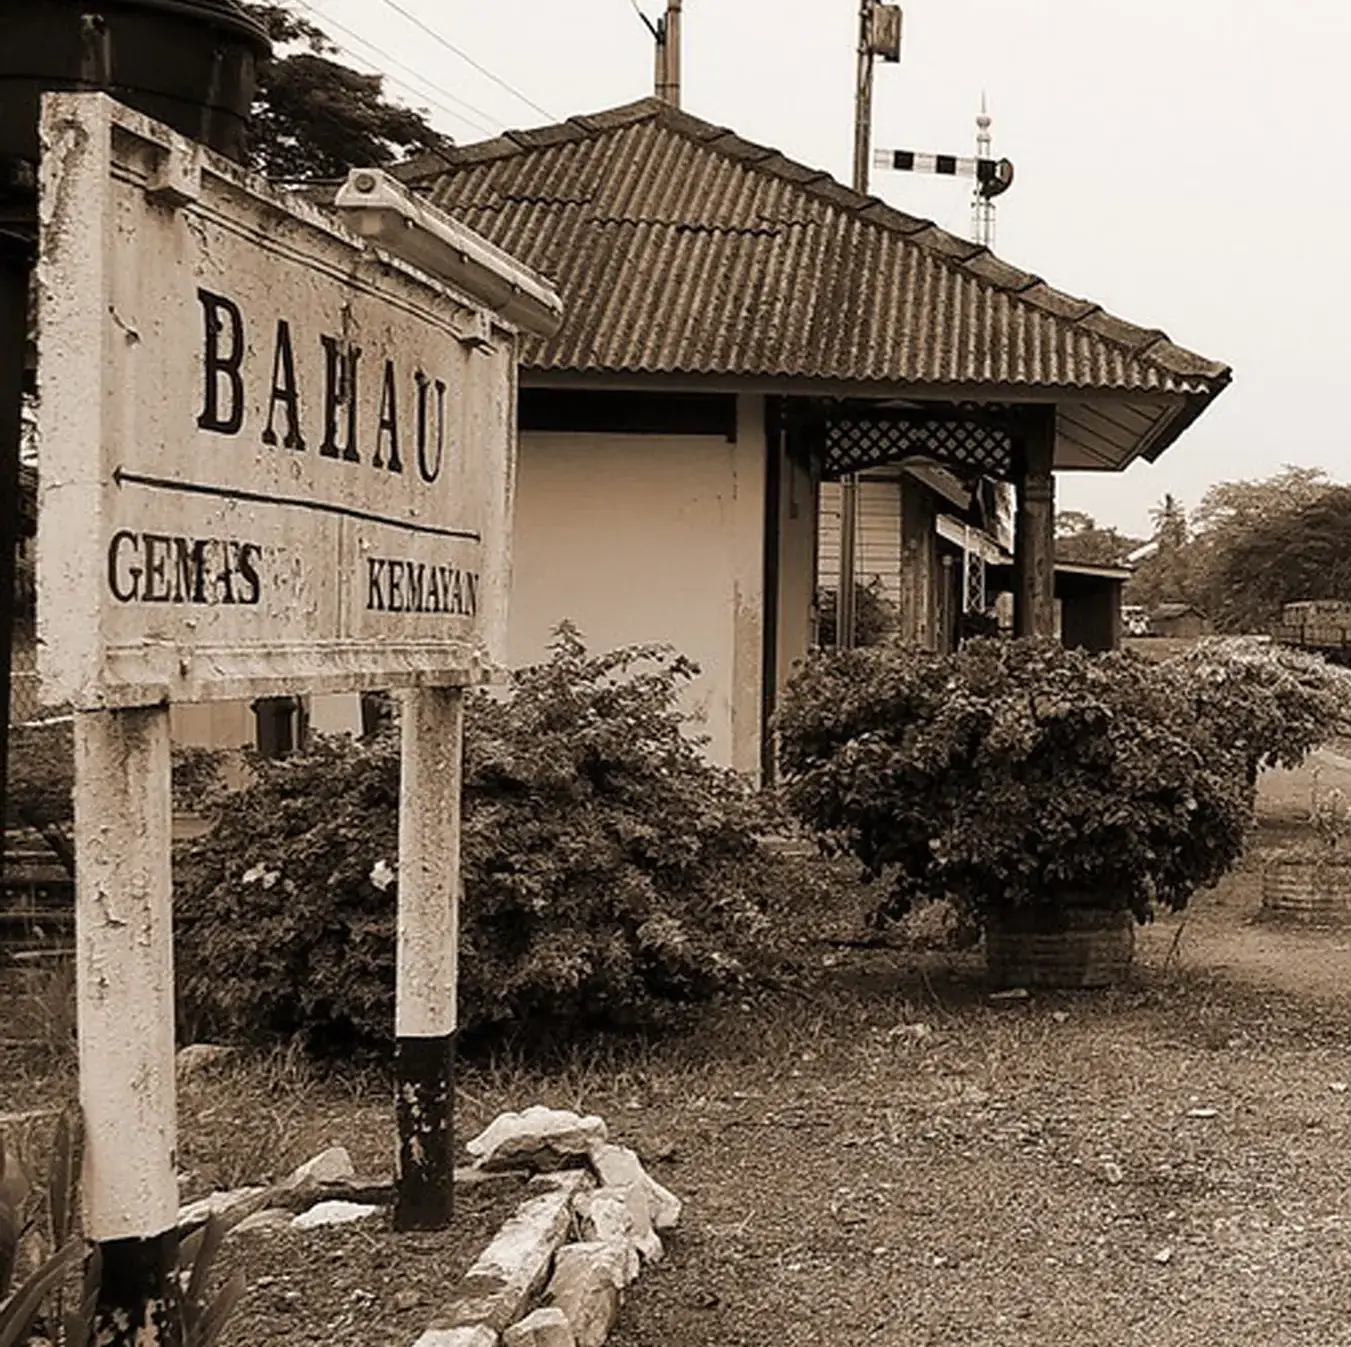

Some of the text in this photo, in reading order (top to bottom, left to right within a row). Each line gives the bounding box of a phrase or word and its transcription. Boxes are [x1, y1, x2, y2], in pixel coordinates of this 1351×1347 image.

[197, 286, 447, 483] BAHAU
[107, 529, 263, 605] GEMAS
[366, 556, 480, 616] KEMAYAN
